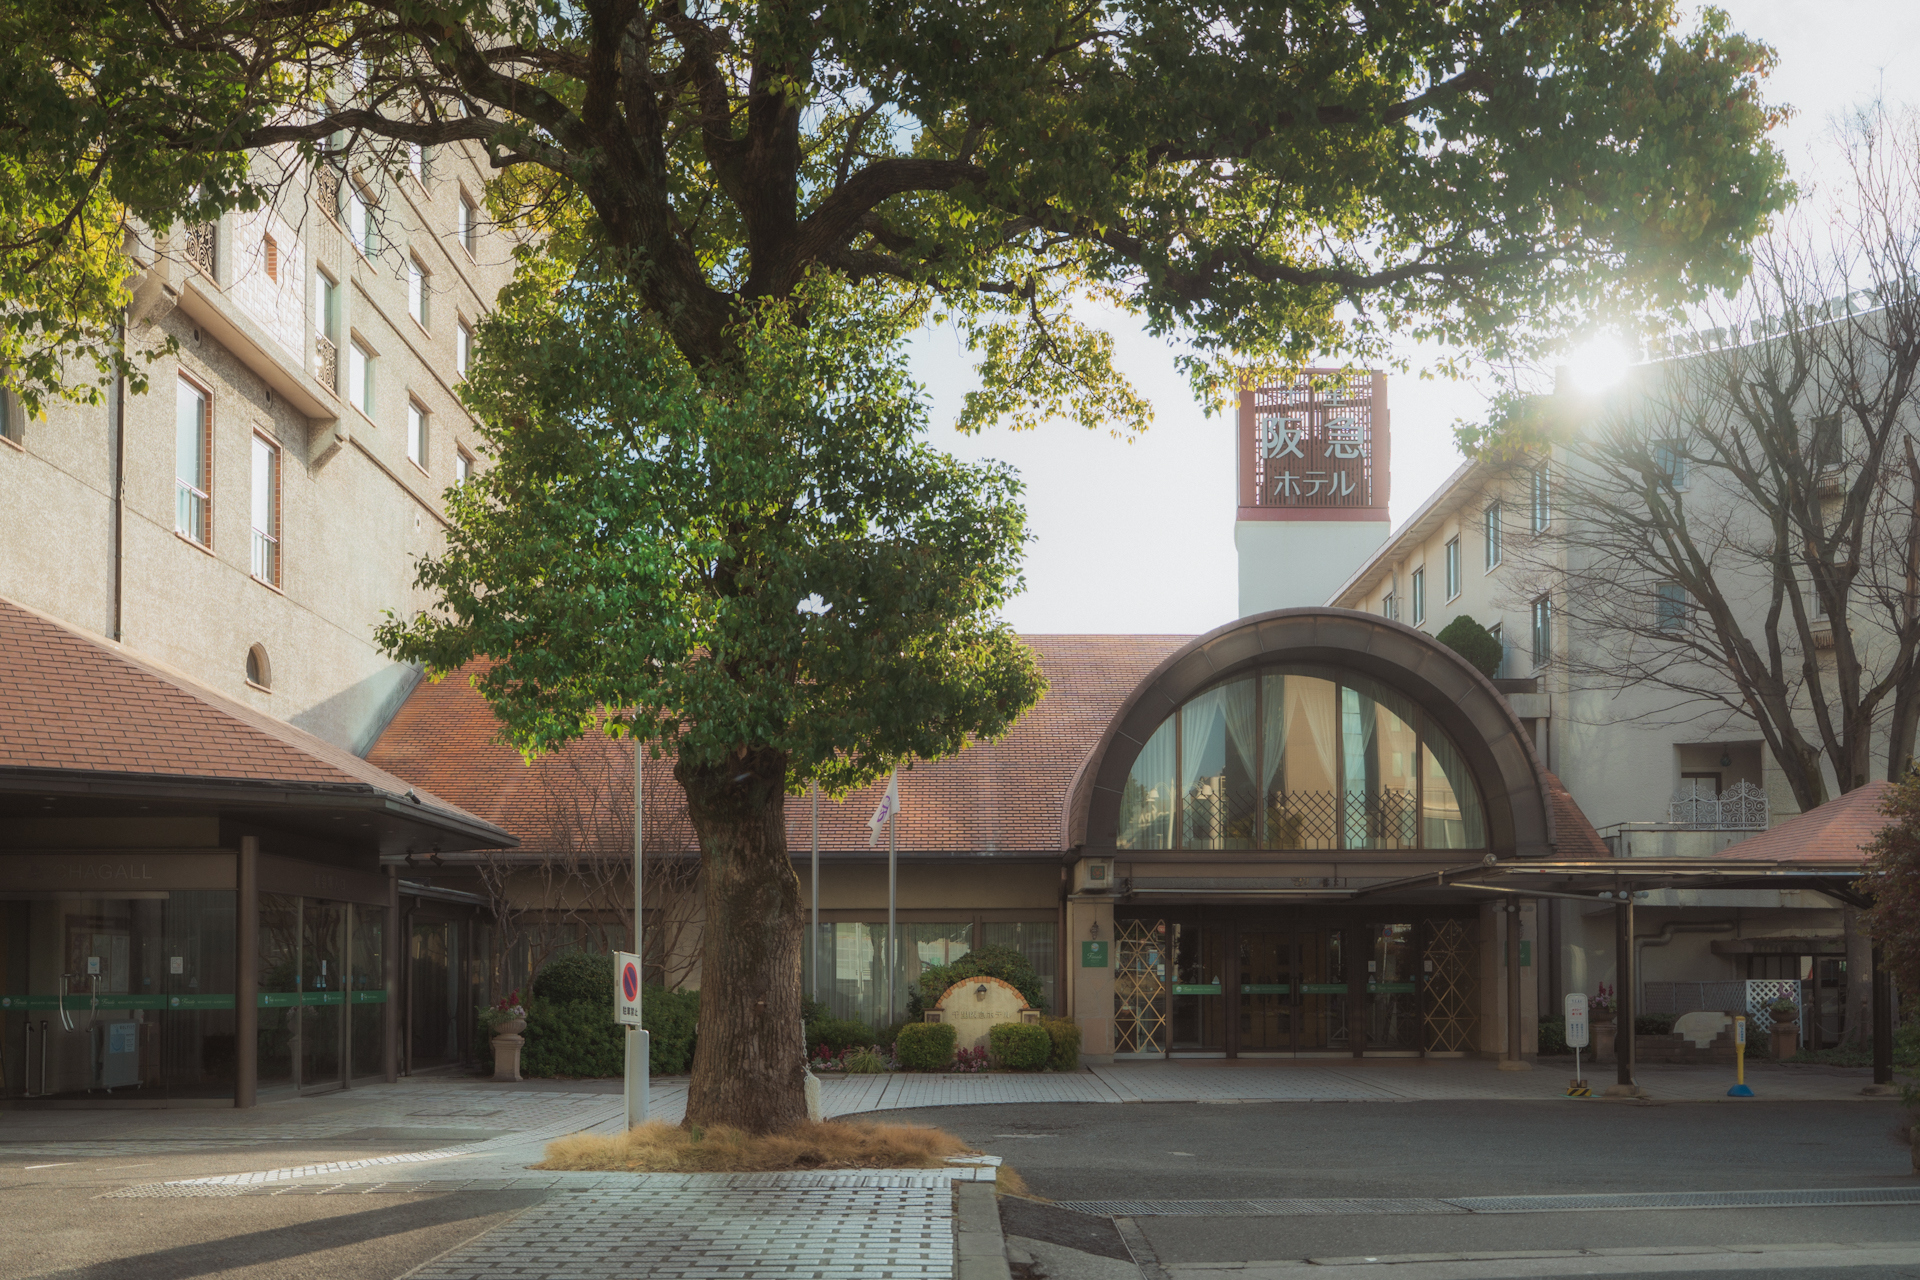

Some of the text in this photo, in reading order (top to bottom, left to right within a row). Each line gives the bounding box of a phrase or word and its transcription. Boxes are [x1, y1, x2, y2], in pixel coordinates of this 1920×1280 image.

[1262, 416, 1367, 459] 阪急
[1273, 470, 1356, 497] ホテル
[53, 863, 153, 880] CHAGALL
[951, 1010, 1011, 1020] 千里阪急ホテル
